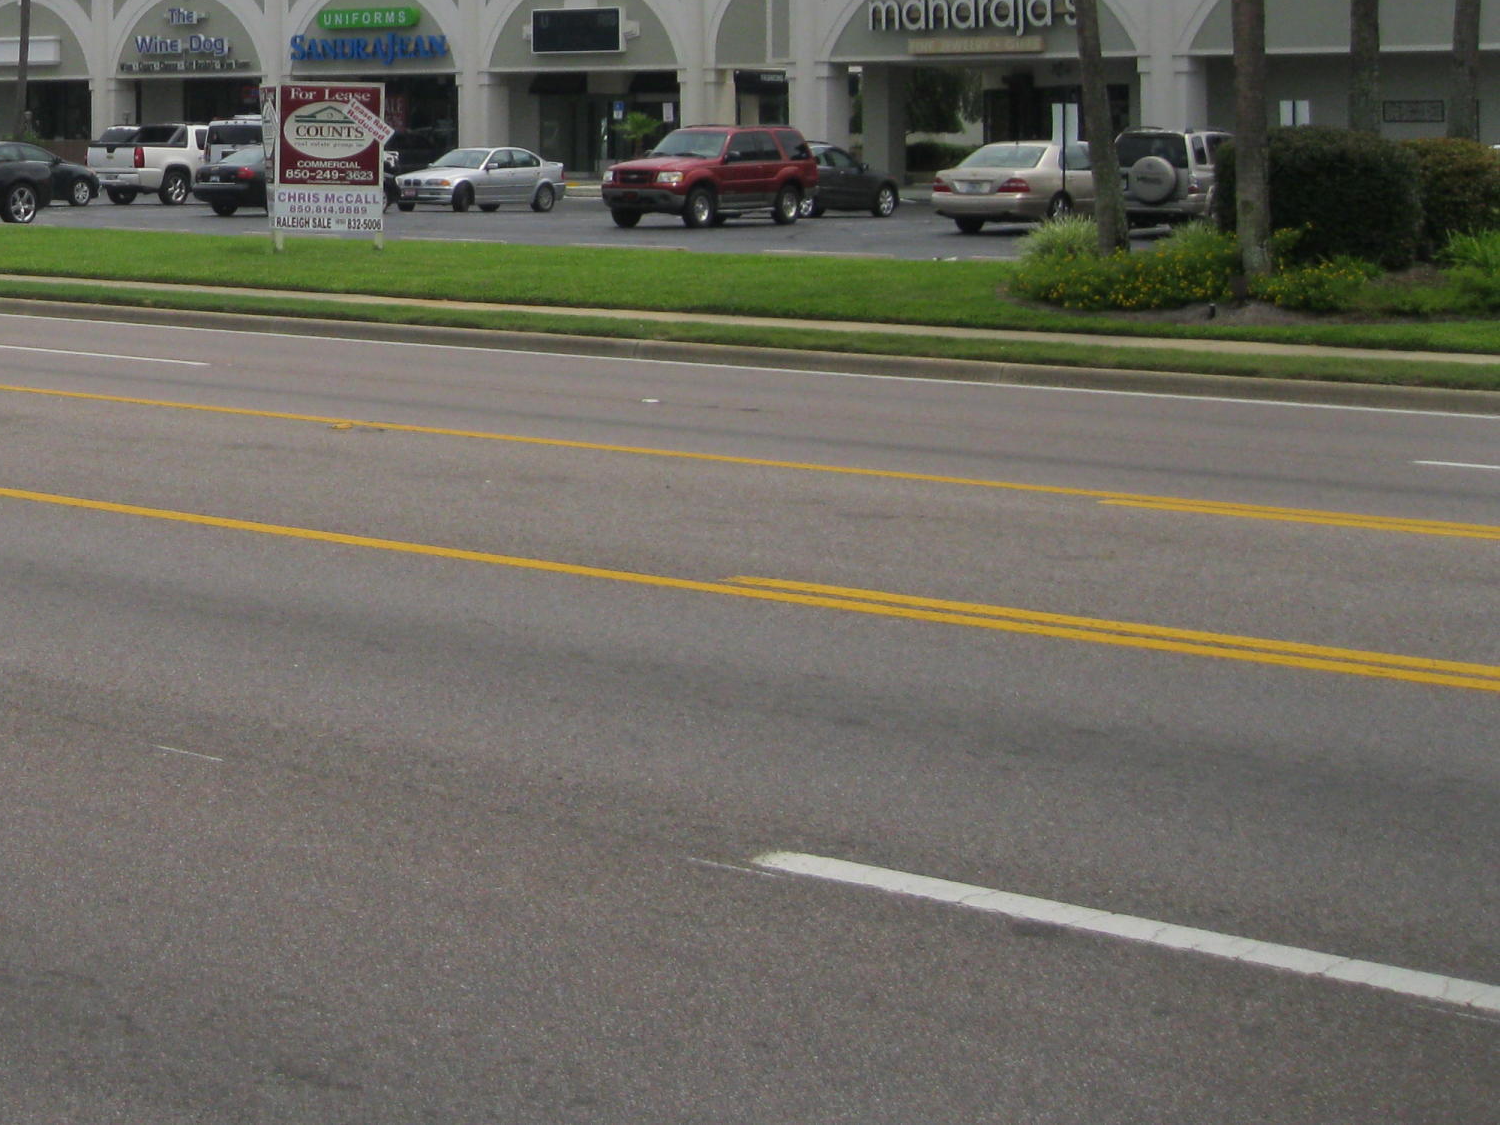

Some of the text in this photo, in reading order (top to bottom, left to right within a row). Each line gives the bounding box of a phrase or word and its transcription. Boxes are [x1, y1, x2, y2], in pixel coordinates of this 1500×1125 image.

[167, 7, 195, 24] The
[323, 10, 407, 26] UNIFORMS
[134, 33, 227, 56] Wine Dog
[290, 87, 372, 101] For Lease
[295, 124, 365, 139] COUNTS
[346, 109, 386, 141] Reduced
[296, 160, 361, 169] COMMERCIAL
[285, 169, 374, 181] 850-249-3623
[277, 191, 380, 204] CHRIS McCALL
[276, 216, 310, 229] RALEIGH
[312, 217, 332, 229] SALE
